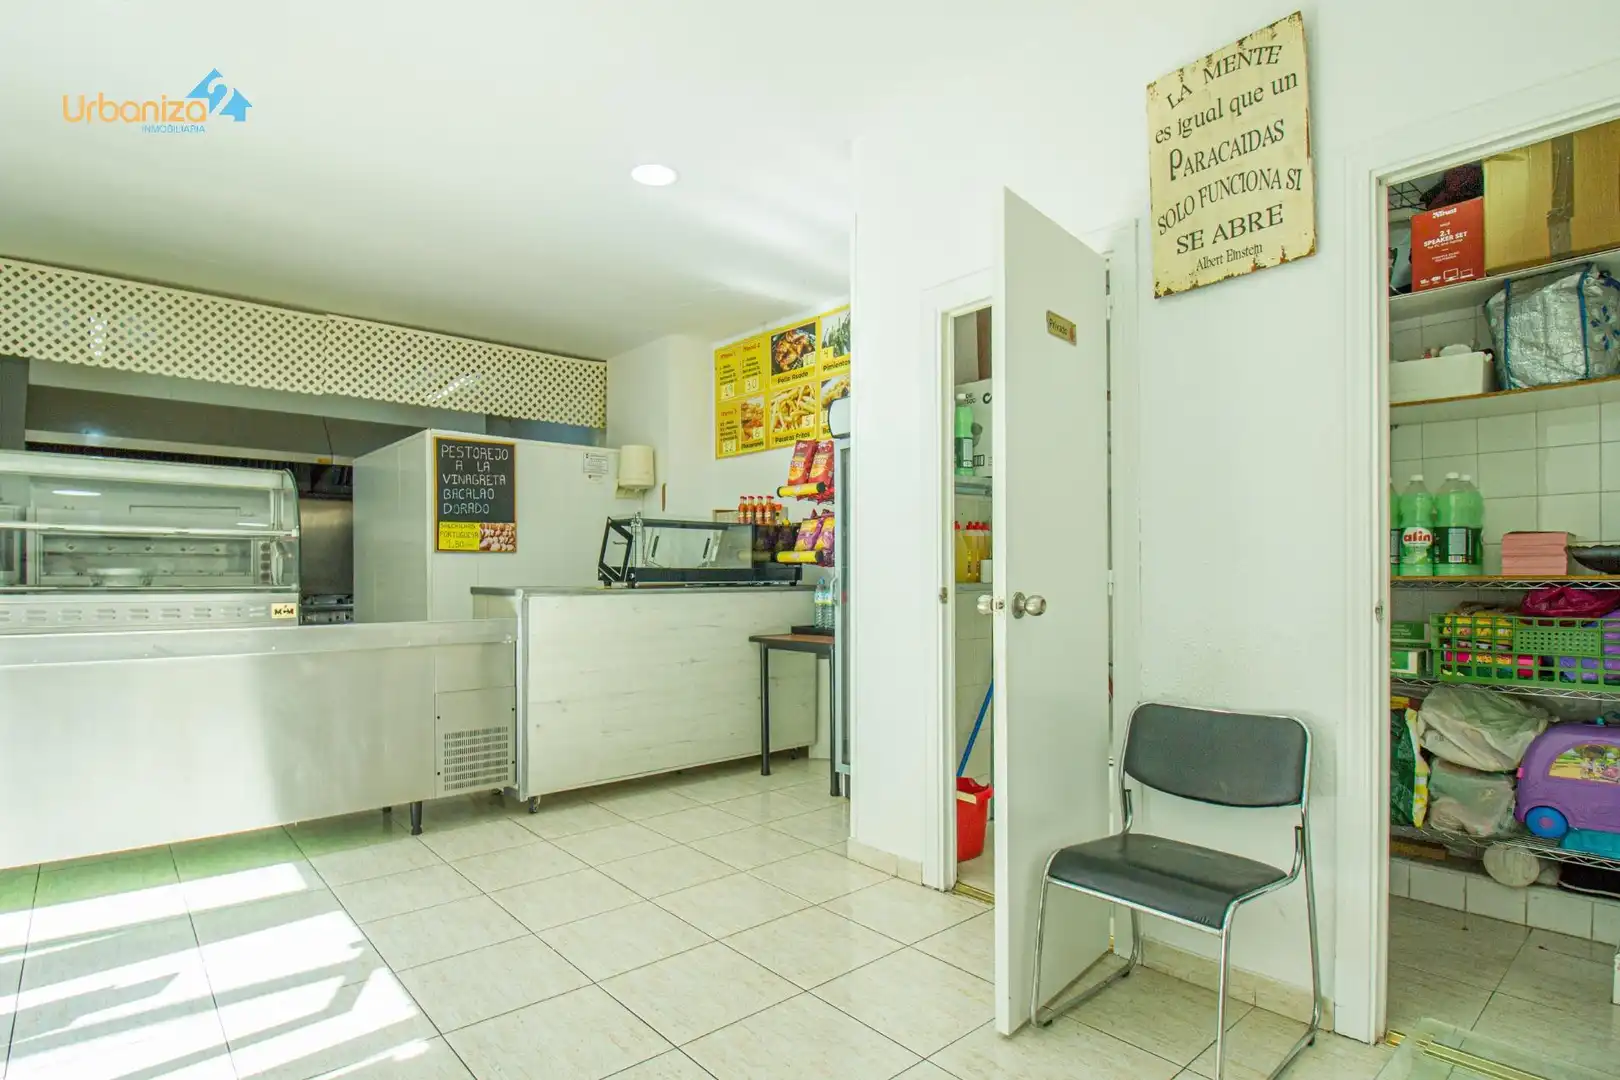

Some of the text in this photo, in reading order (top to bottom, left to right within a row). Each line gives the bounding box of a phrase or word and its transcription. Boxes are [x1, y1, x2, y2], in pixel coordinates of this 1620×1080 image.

[1166, 45, 1283, 110] LA MENTE
[1155, 72, 1298, 145] es igual que un
[1169, 118, 1286, 182] PARACAIDAS
[1157, 167, 1303, 236] SOLO FUNCIONA SI
[1436, 207, 1457, 219] Trust
[1176, 203, 1284, 255] SE ABRE
[1440, 229, 1450, 237] 2.1
[1423, 231, 1468, 248] SPEAKER SET
[1196, 243, 1264, 272] Albert Einstein
[1049, 317, 1068, 336] Privado
[777, 370, 808, 383] Pollo Asado
[441, 444, 509, 461] PESTOREJO
[455, 460, 491, 472] A LA
[442, 473, 507, 487] VINAGRETA
[443, 488, 495, 500] BACALAO
[443, 503, 490, 515] DORADO
